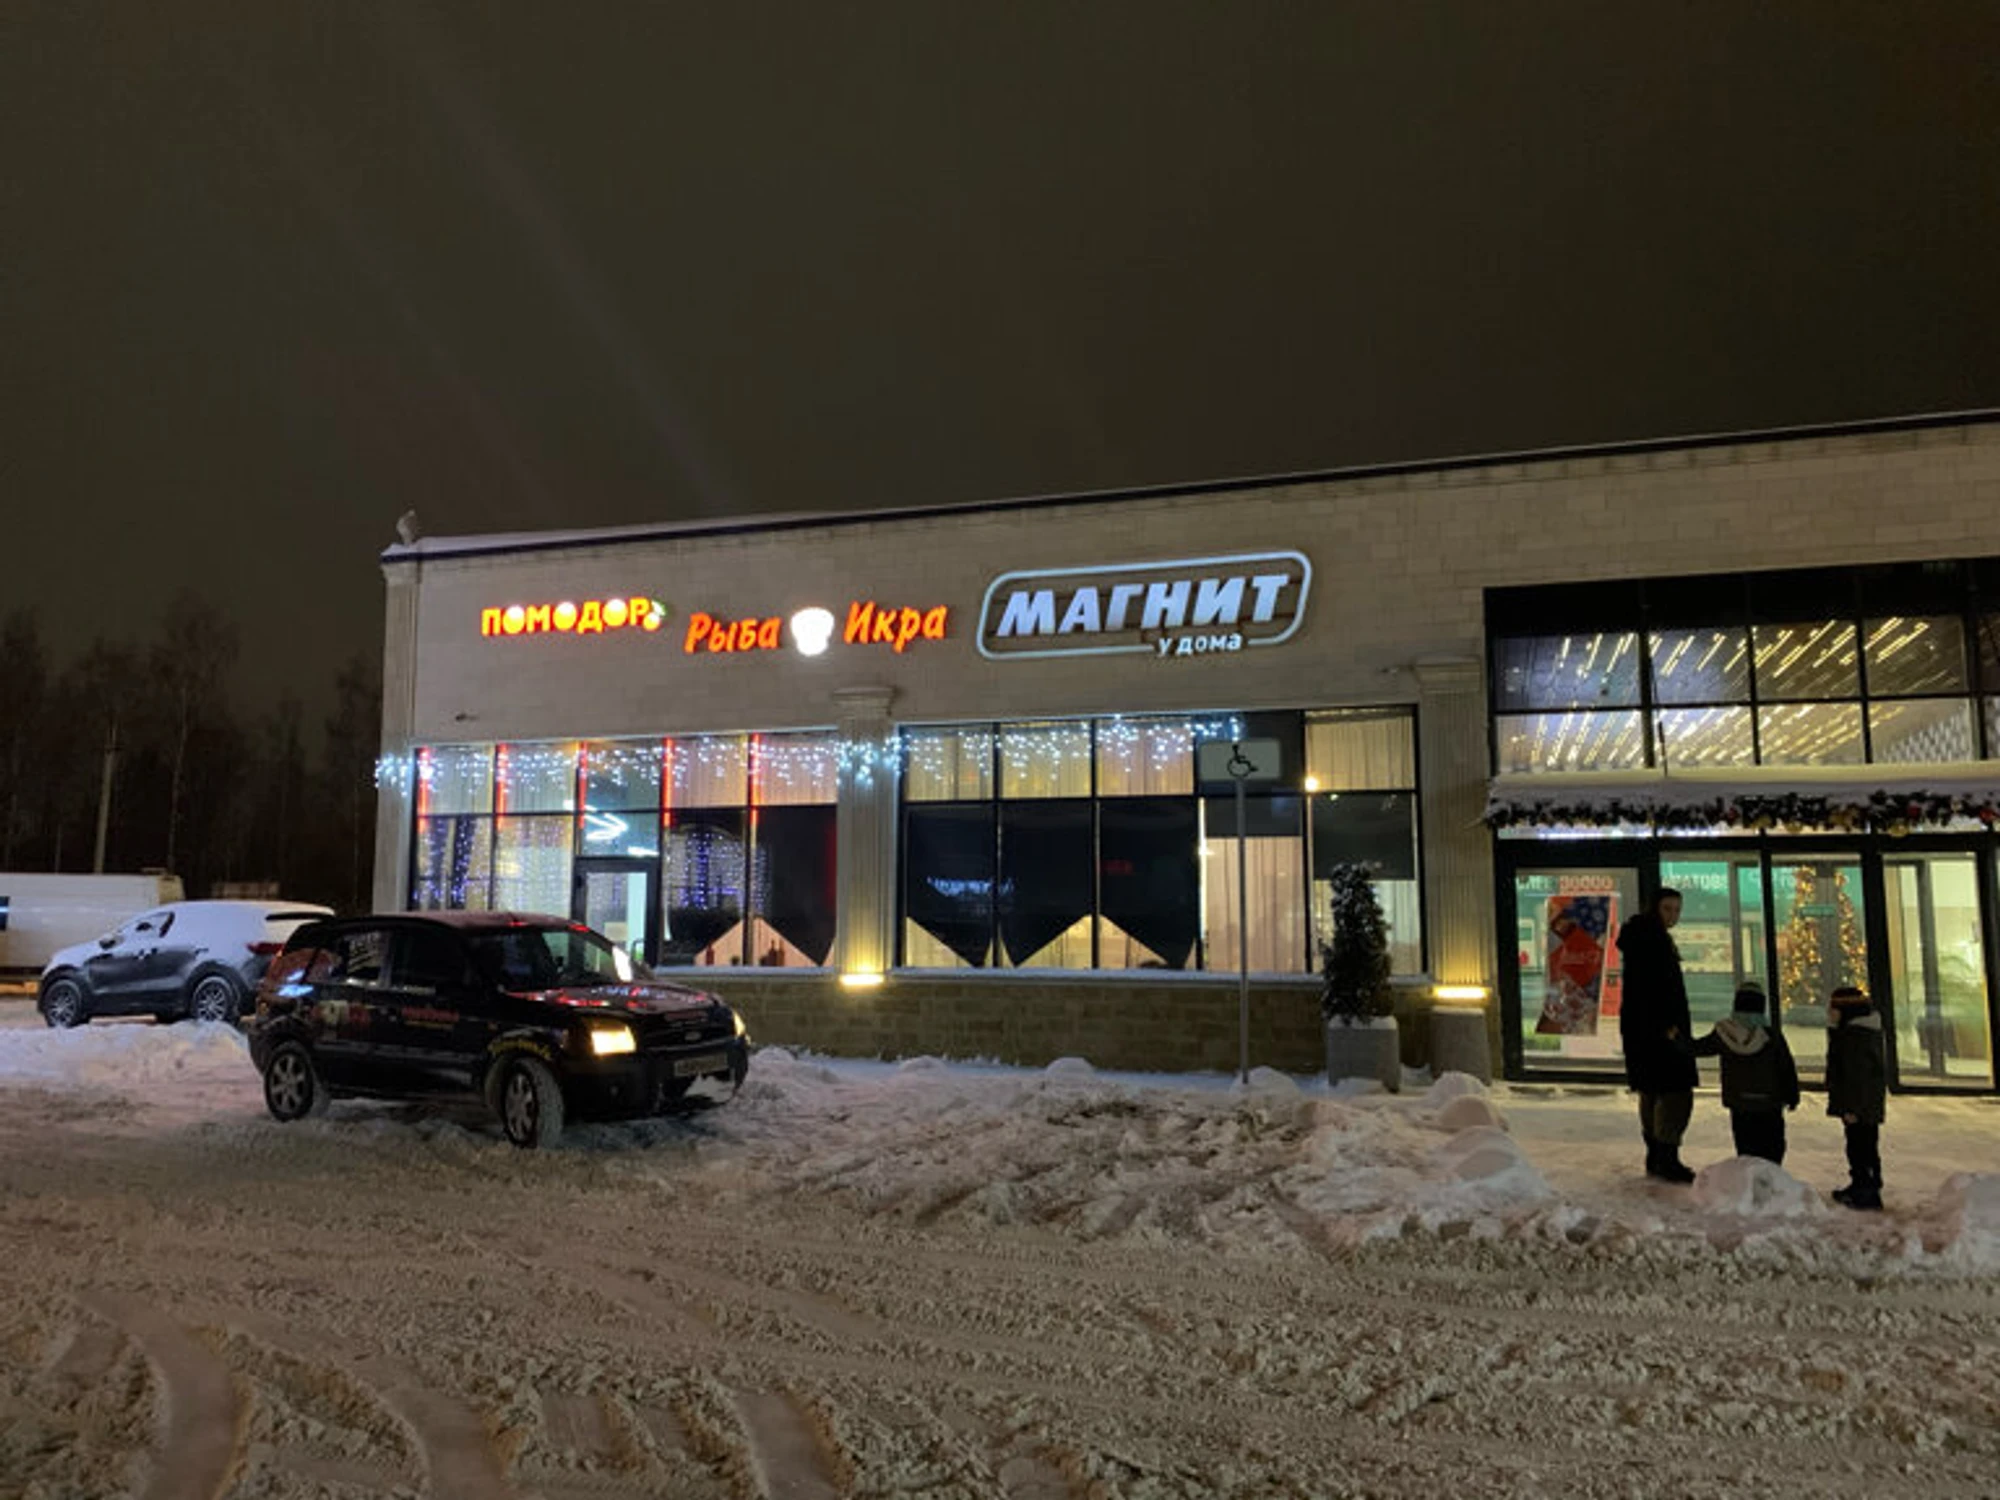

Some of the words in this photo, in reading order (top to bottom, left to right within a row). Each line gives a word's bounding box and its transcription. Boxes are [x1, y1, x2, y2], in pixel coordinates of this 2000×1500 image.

[684, 612, 783, 654] Рыба
[843, 602, 948, 653] Икра
[996, 575, 1289, 637] МАГНИТ
[1157, 638, 1173, 657] у
[1175, 632, 1243, 656] дома
